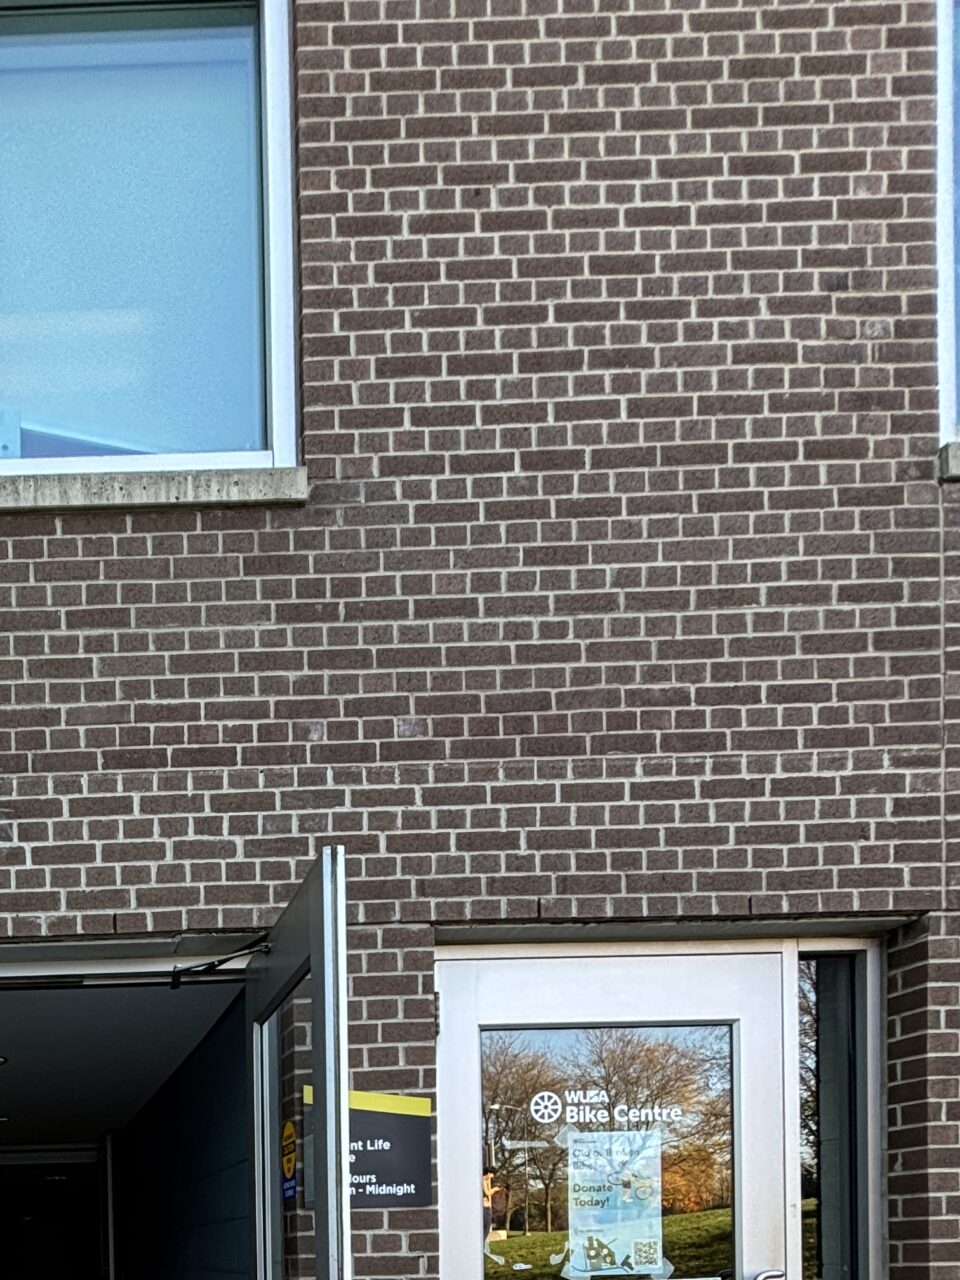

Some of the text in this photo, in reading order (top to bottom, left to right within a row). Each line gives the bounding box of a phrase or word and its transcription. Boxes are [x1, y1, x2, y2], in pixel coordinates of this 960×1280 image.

[565, 1090, 609, 1104] WUSA
[566, 1104, 682, 1123] Bike Centre
[367, 1139, 391, 1151] Life
[366, 1183, 416, 1196] Midnight
[572, 1183, 614, 1193] Donate
[572, 1196, 610, 1208] Today!
